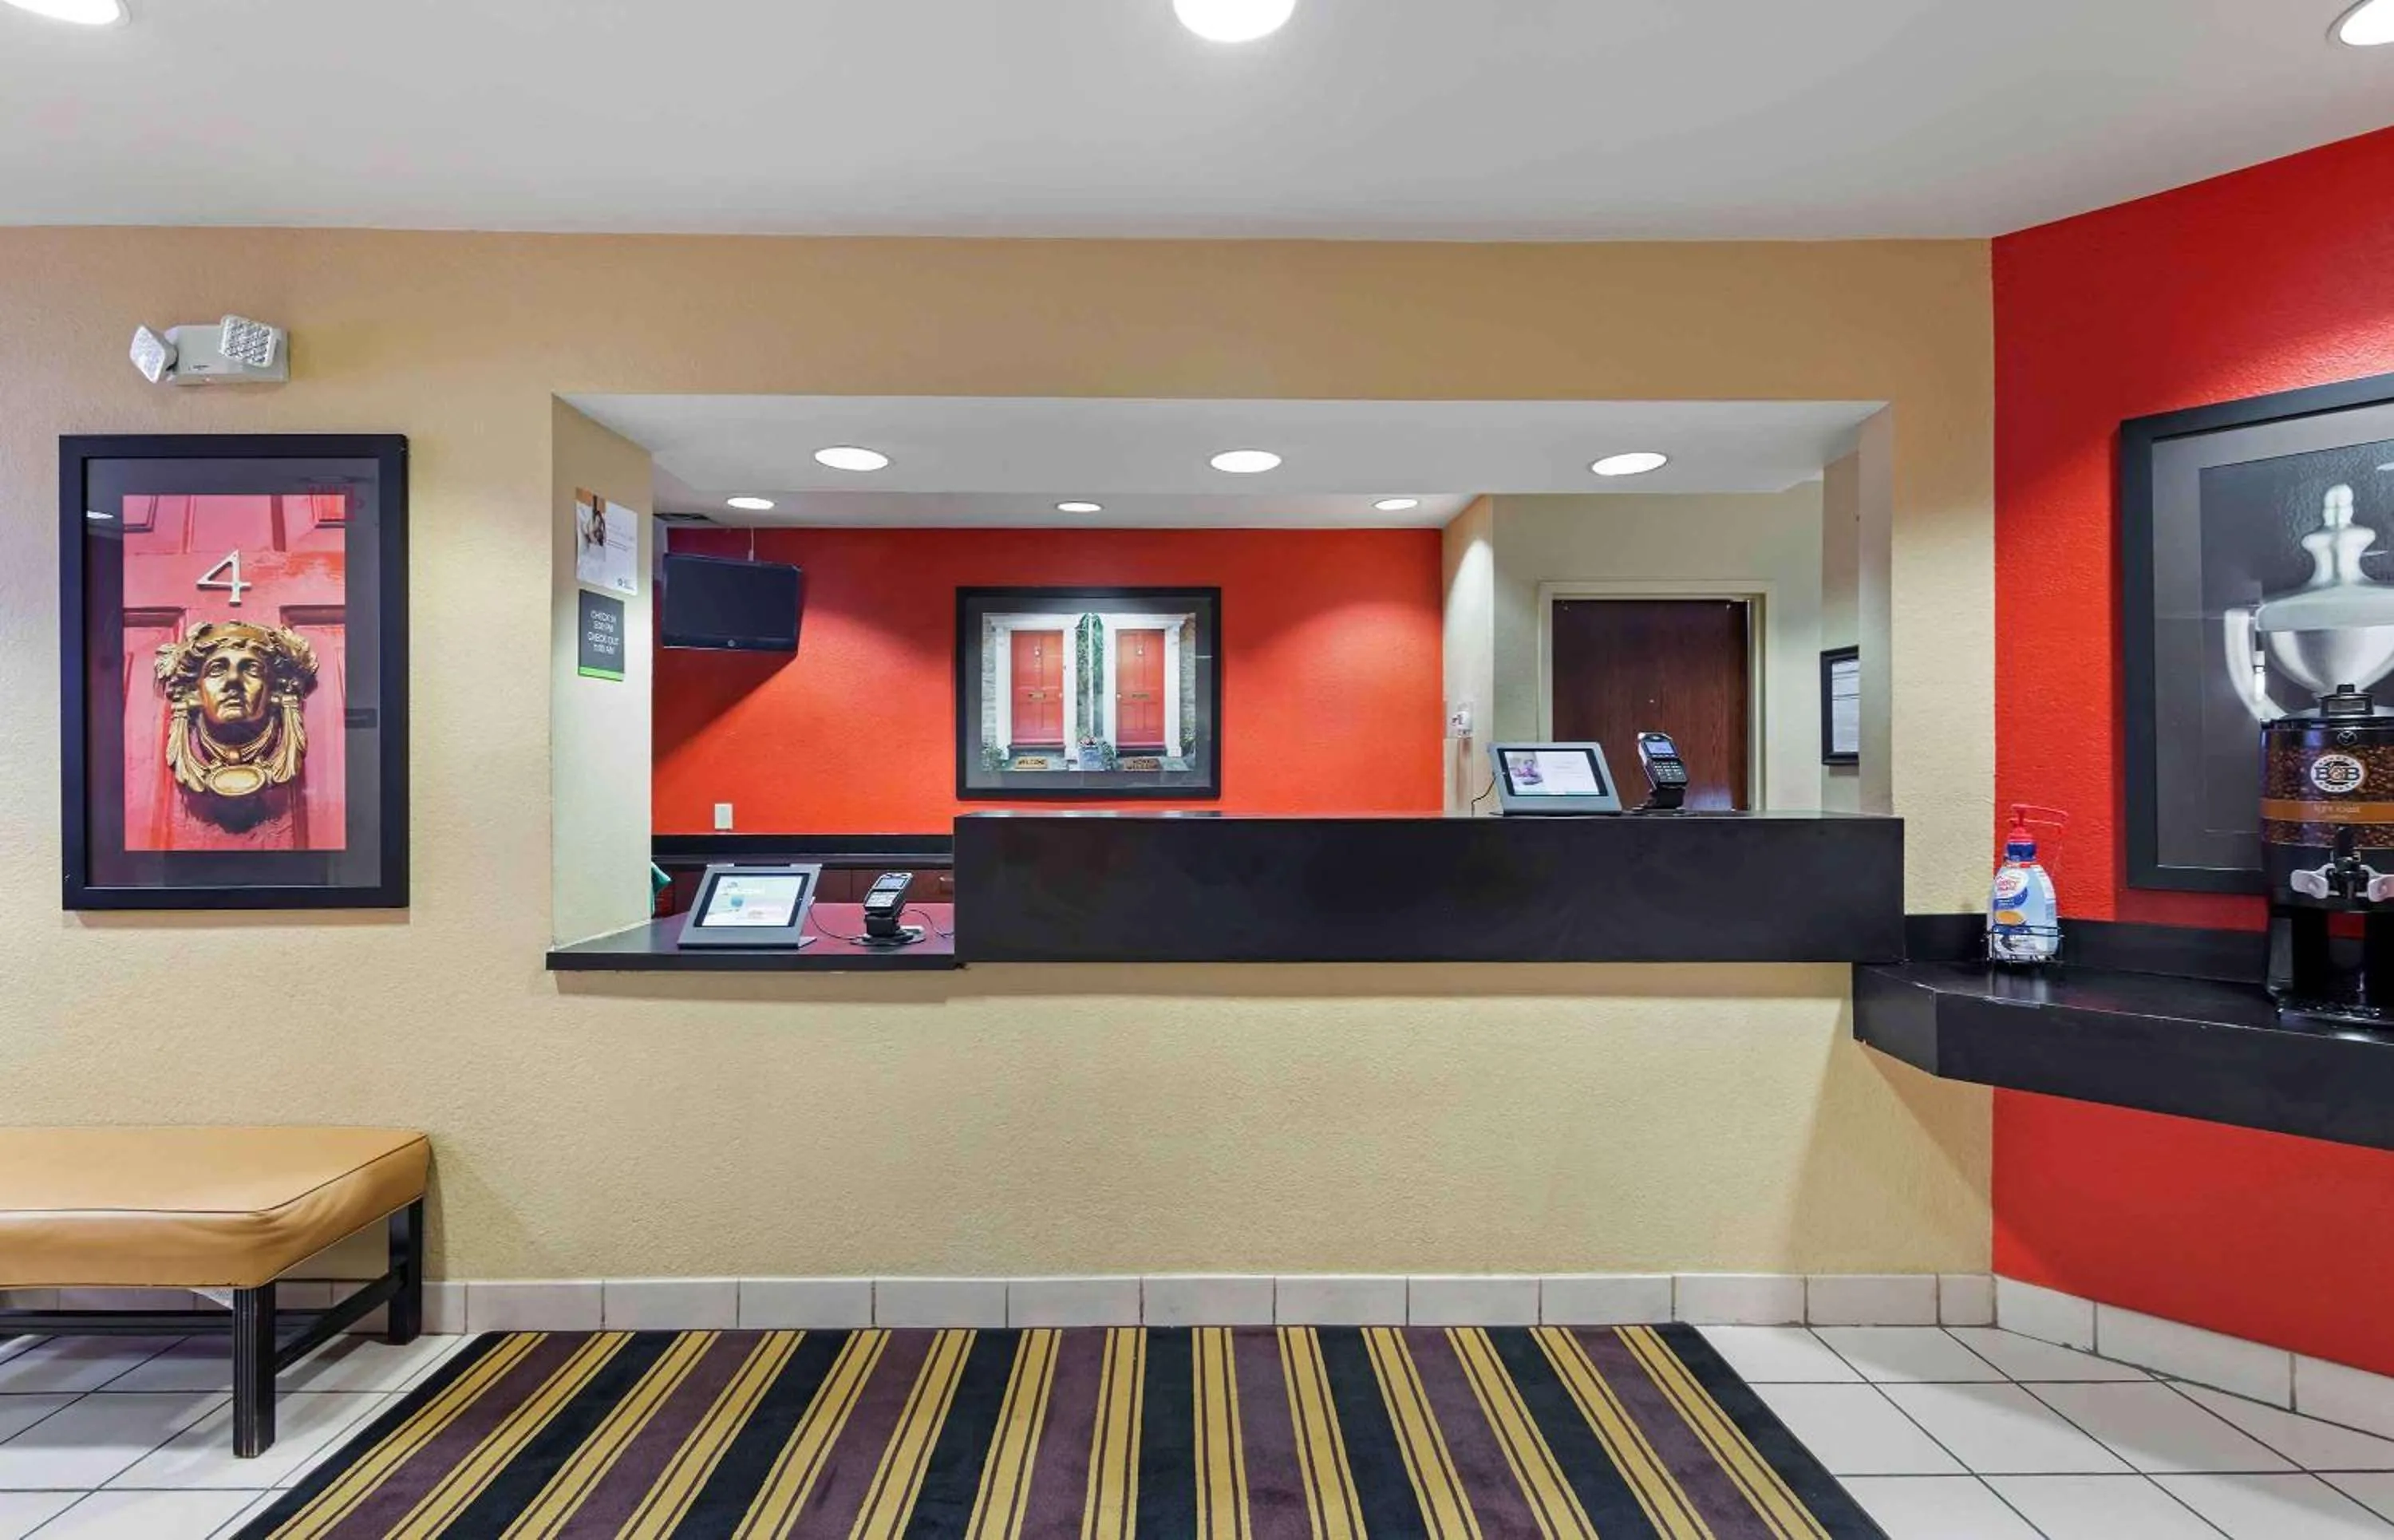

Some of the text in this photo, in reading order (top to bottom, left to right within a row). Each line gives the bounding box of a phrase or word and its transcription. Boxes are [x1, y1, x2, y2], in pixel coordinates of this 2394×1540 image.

[196, 549, 252, 607] 4
[587, 631, 619, 646] CHECK OUT
